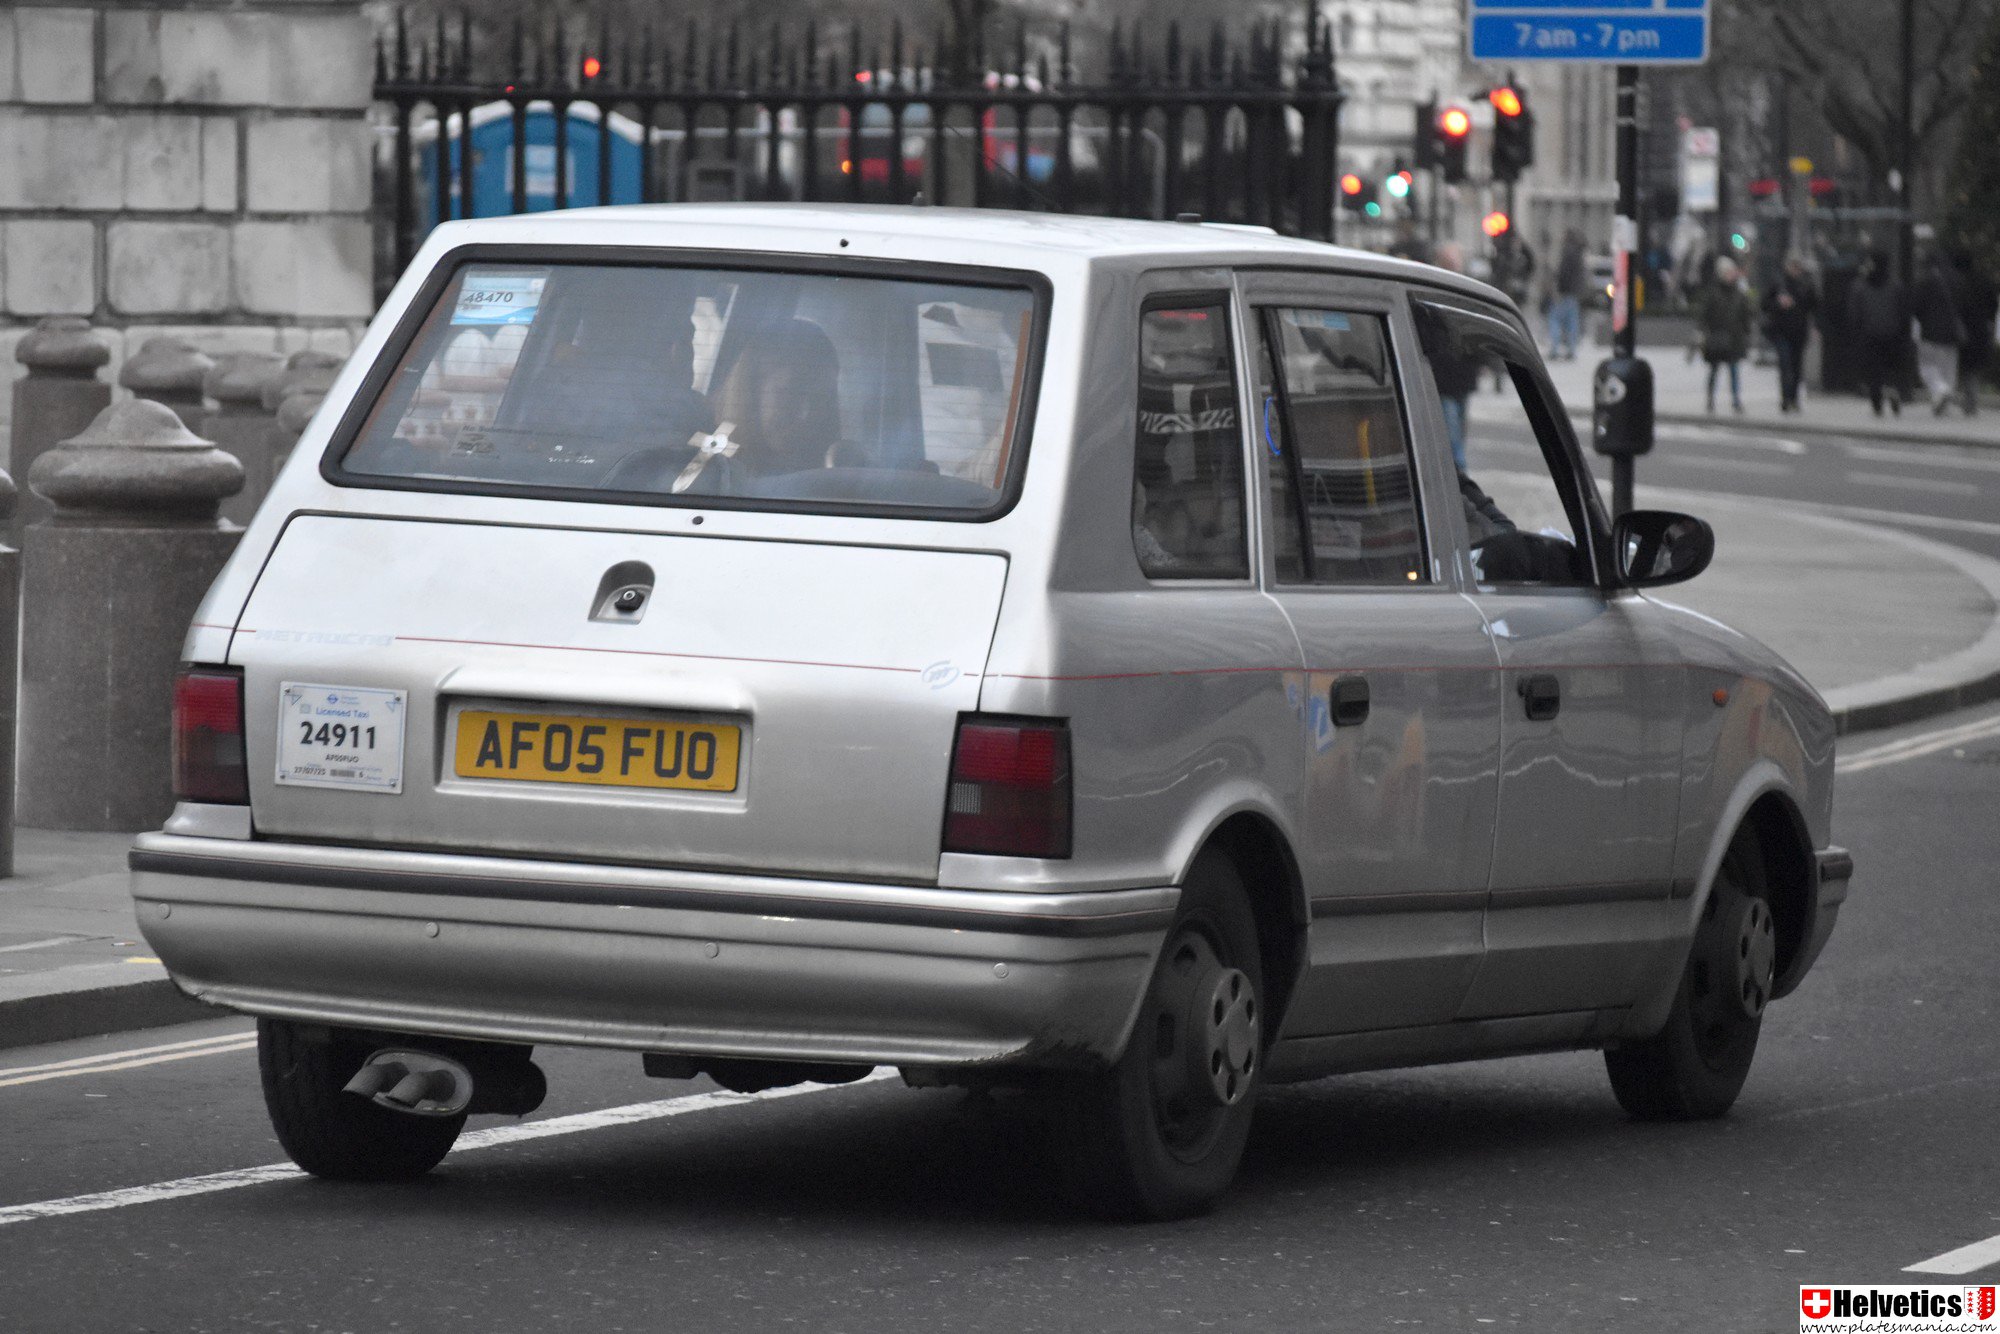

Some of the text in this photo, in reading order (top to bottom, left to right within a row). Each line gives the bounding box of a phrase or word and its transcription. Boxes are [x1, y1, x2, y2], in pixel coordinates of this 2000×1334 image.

[1515, 23, 1577, 49] 7am
[1598, 23, 1661, 53] 7pm
[464, 291, 514, 303] 48470
[315, 707, 370, 719] Licensed Taxi
[300, 720, 376, 750] 24911
[475, 720, 717, 781] AF05 FUO
